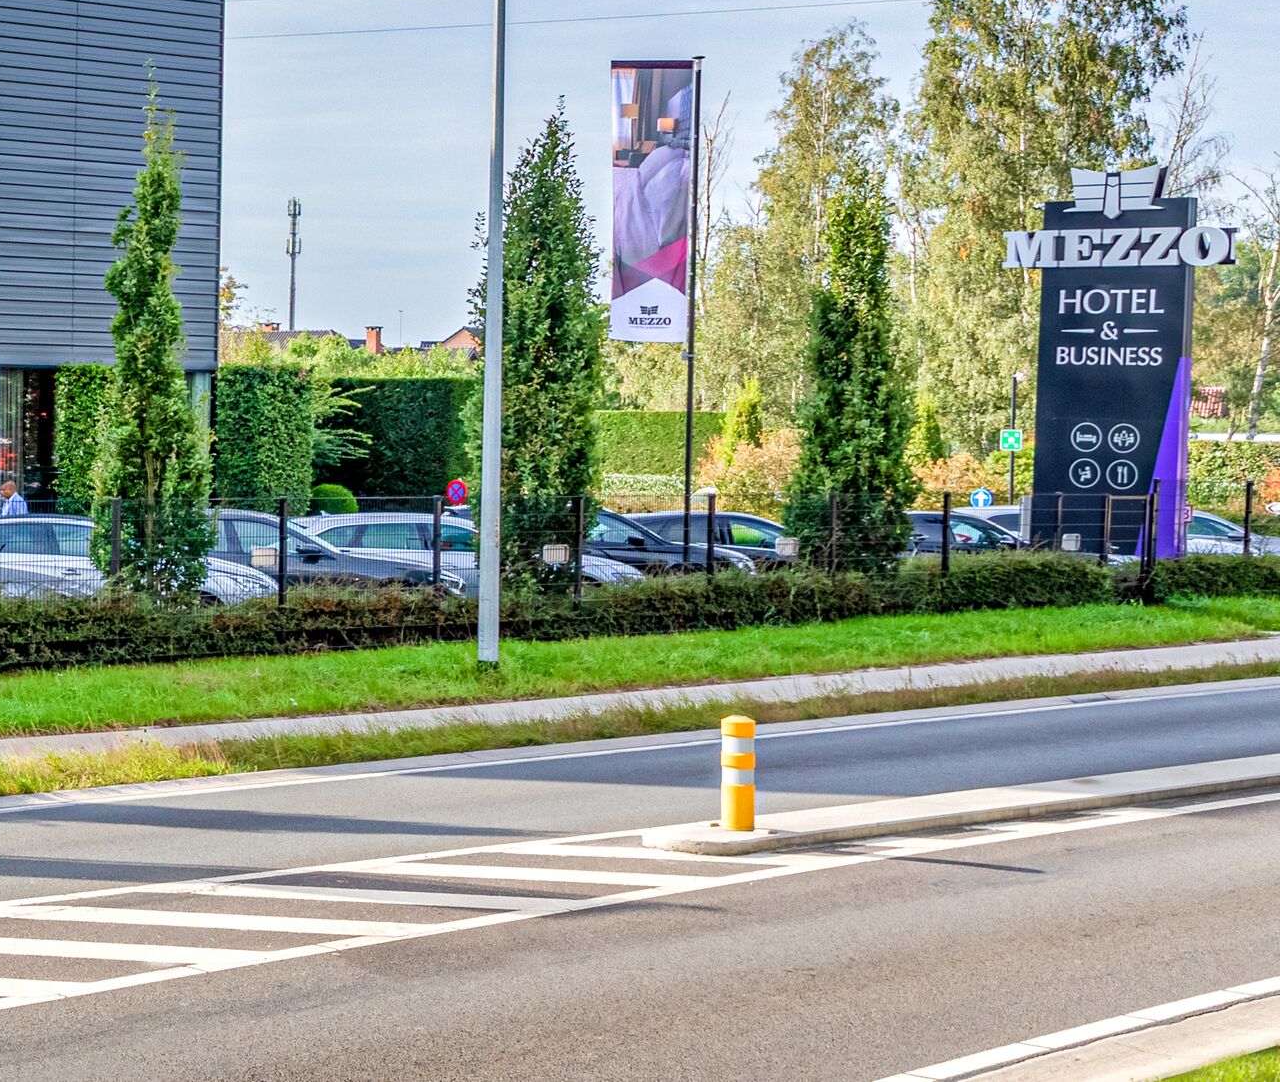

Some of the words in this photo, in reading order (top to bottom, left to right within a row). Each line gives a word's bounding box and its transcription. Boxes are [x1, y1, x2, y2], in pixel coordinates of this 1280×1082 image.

[1001, 226, 1230, 269] MEZZO
[1058, 289, 1165, 315] HOTEL
[628, 316, 672, 326] MEZZO
[1100, 320, 1119, 341] &
[1055, 346, 1163, 366] BUSINESS
